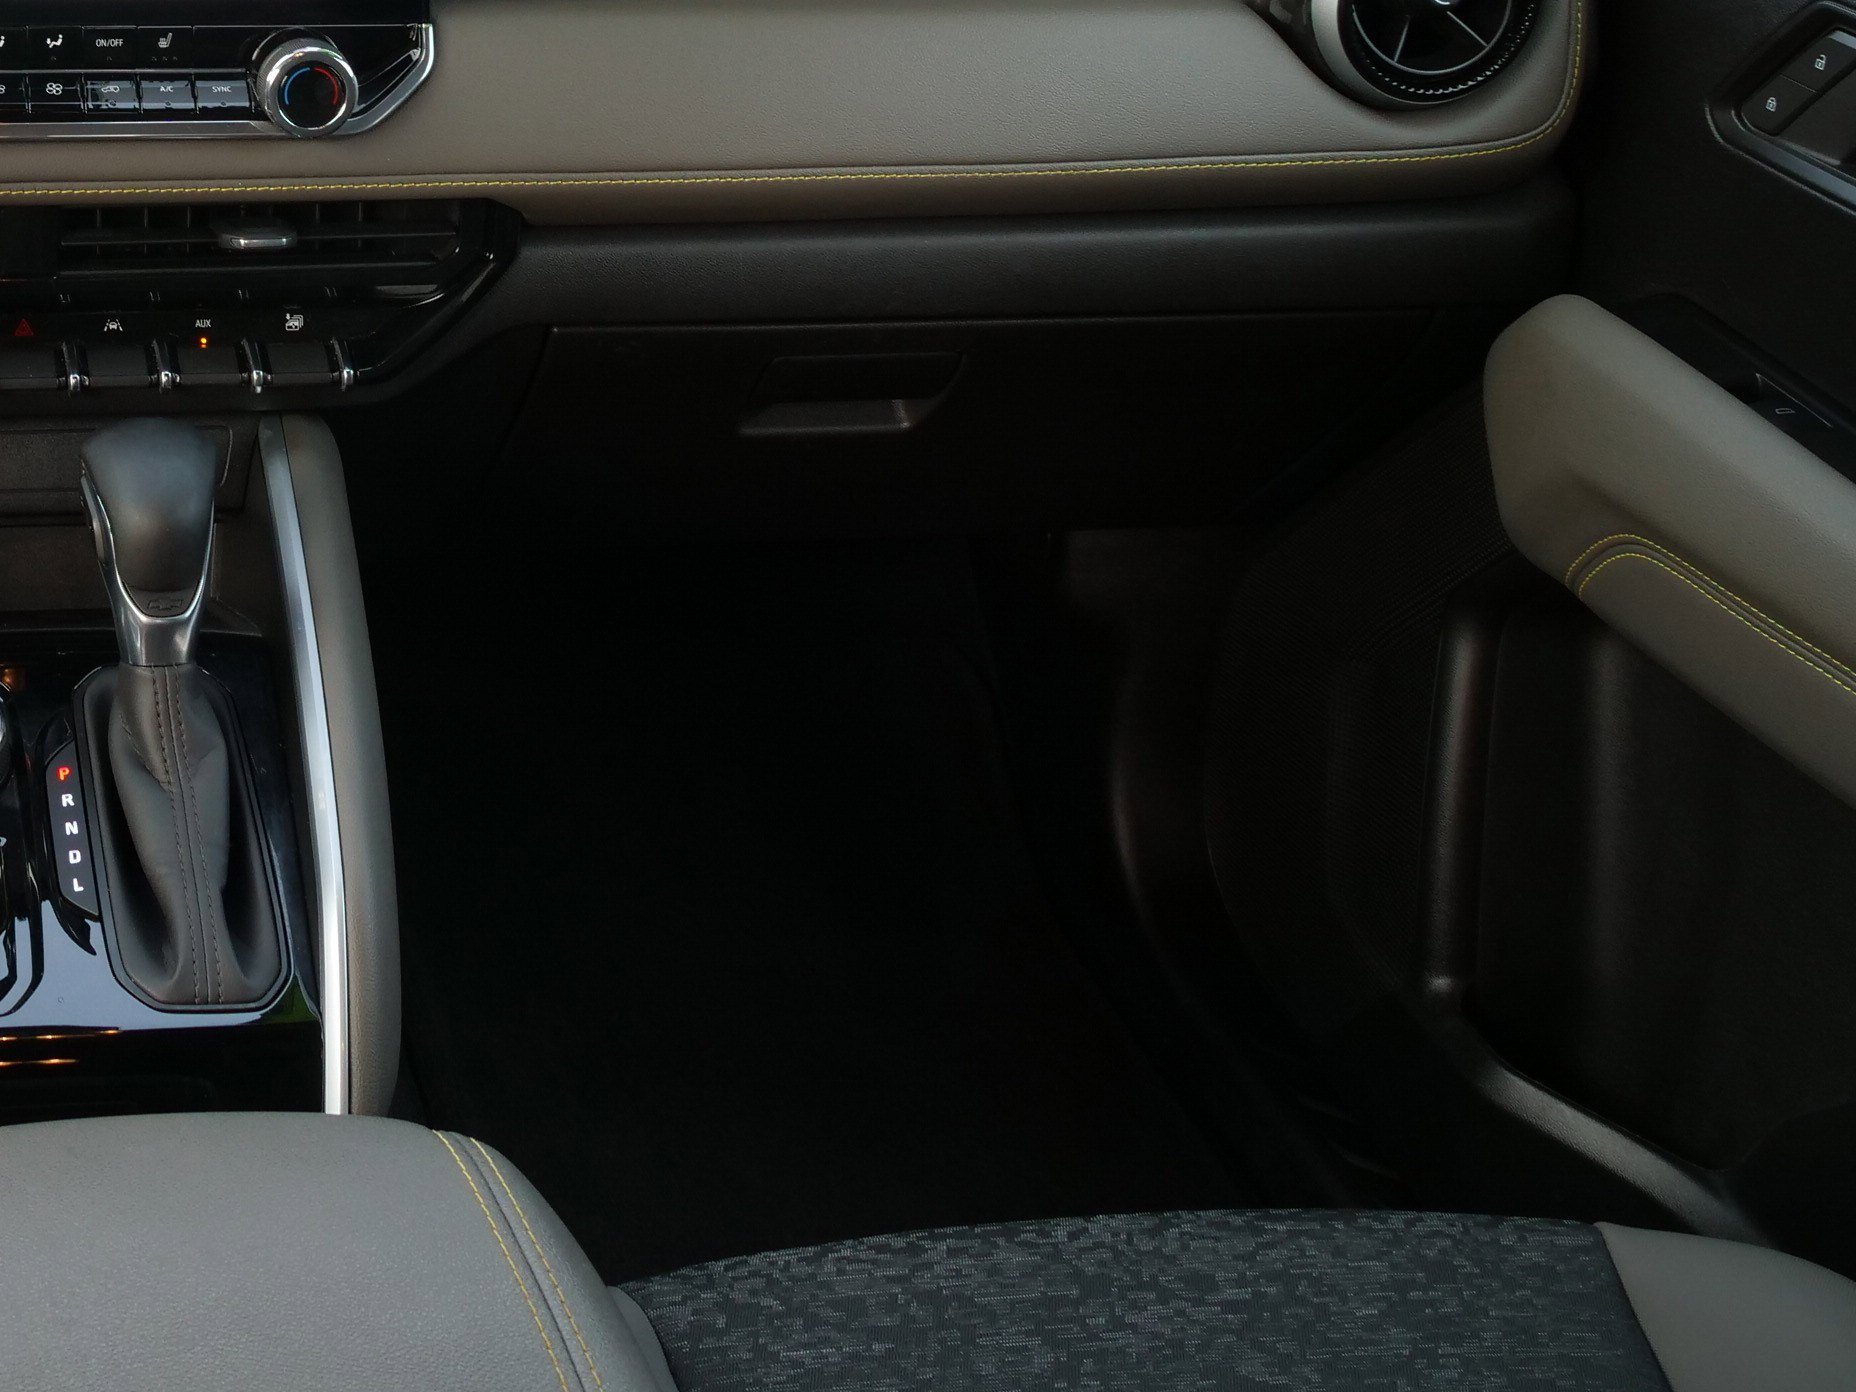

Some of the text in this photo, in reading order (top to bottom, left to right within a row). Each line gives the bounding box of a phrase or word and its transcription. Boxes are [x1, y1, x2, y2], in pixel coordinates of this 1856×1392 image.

[95, 38, 124, 48] ON/OFF
[160, 85, 174, 93] A/C
[211, 85, 232, 93] SYNC
[195, 319, 212, 328] AUX
[58, 766, 70, 781] P
[61, 793, 75, 808] R
[65, 821, 79, 836] N
[68, 849, 82, 864] D
[72, 877, 84, 893] L
